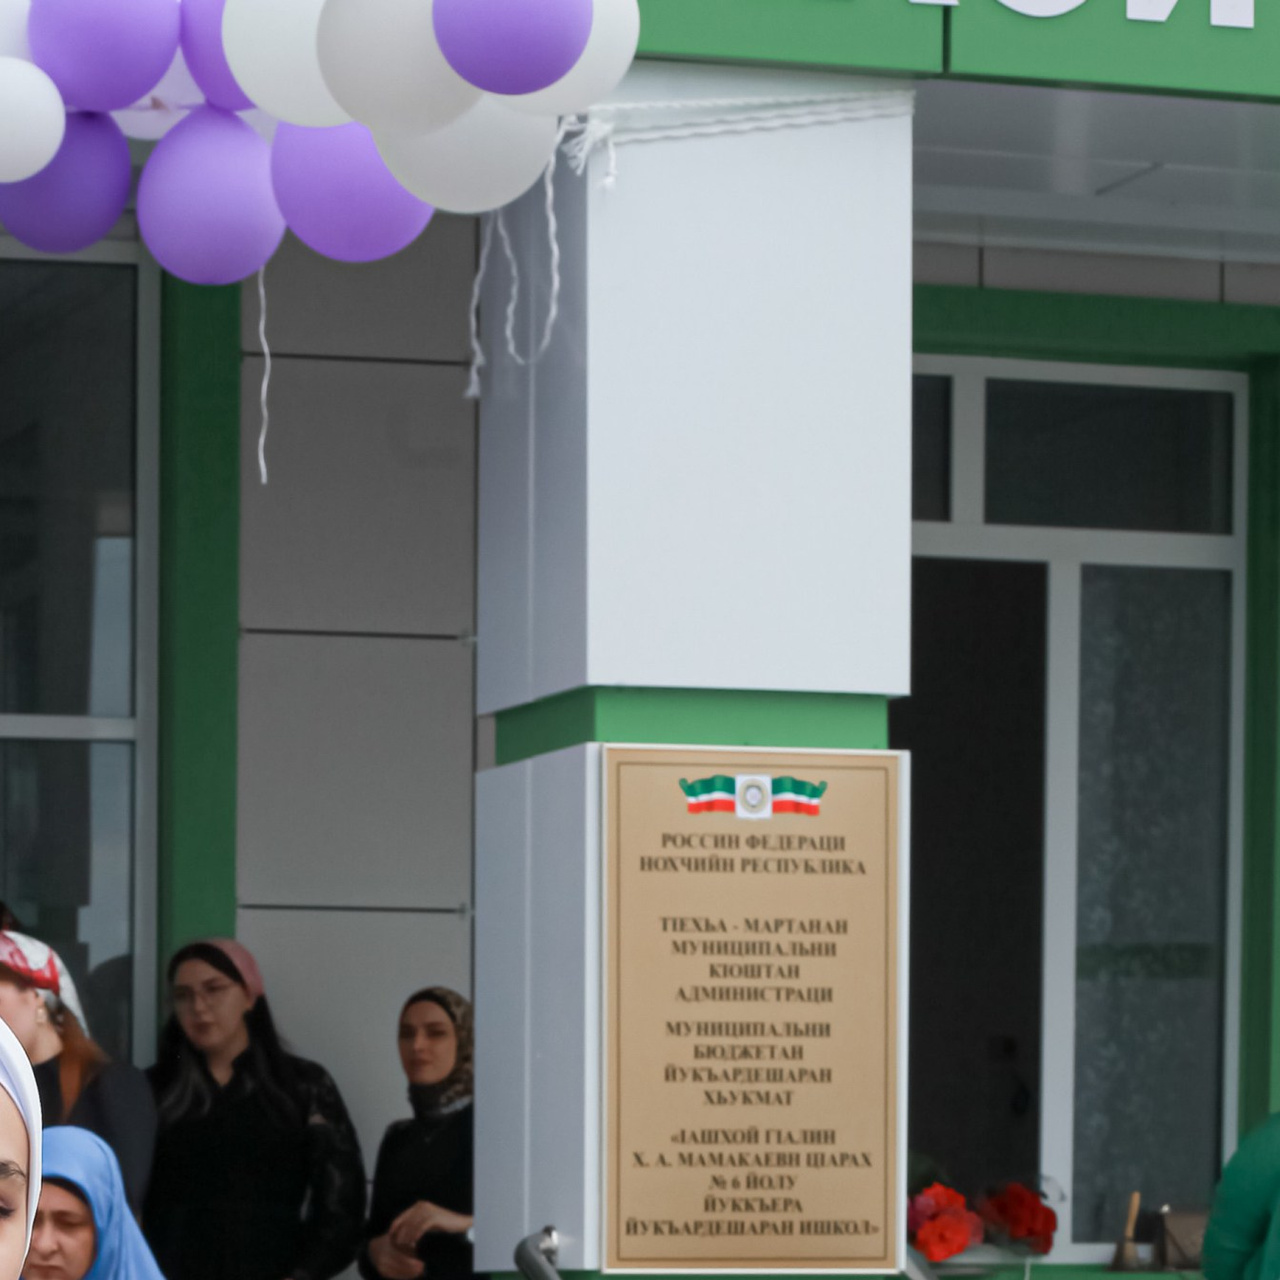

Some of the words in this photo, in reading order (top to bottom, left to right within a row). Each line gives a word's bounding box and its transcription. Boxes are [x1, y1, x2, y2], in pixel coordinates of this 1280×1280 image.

[745, 834, 846, 852] ФЕДЕРАЦИ
[640, 855, 735, 873] НОХЧИЙН
[741, 857, 867, 875] РЕСПУБЛИКА
[671, 940, 837, 957] МУНИЦИПАЛЬНИ
[675, 986, 833, 1003] АДМИНИСТРАЦИ
[666, 1021, 831, 1038] МУНИЦИПАЛЬНИ
[693, 1045, 804, 1061] БЮДЖЕТАН
[664, 1065, 832, 1083] ЙУКЪАРДЕШАРАН
[704, 1090, 794, 1106] ХЬУКМАТ
[633, 1152, 649, 1167] Х.
[656, 1153, 673, 1167] А.
[731, 1175, 741, 1190] 6
[745, 1172, 798, 1191] ЙОЛУ
[703, 1196, 804, 1213] ЙУККЪЕРА
[625, 1219, 794, 1237] ЙУКЪАРДЕШАРАН
